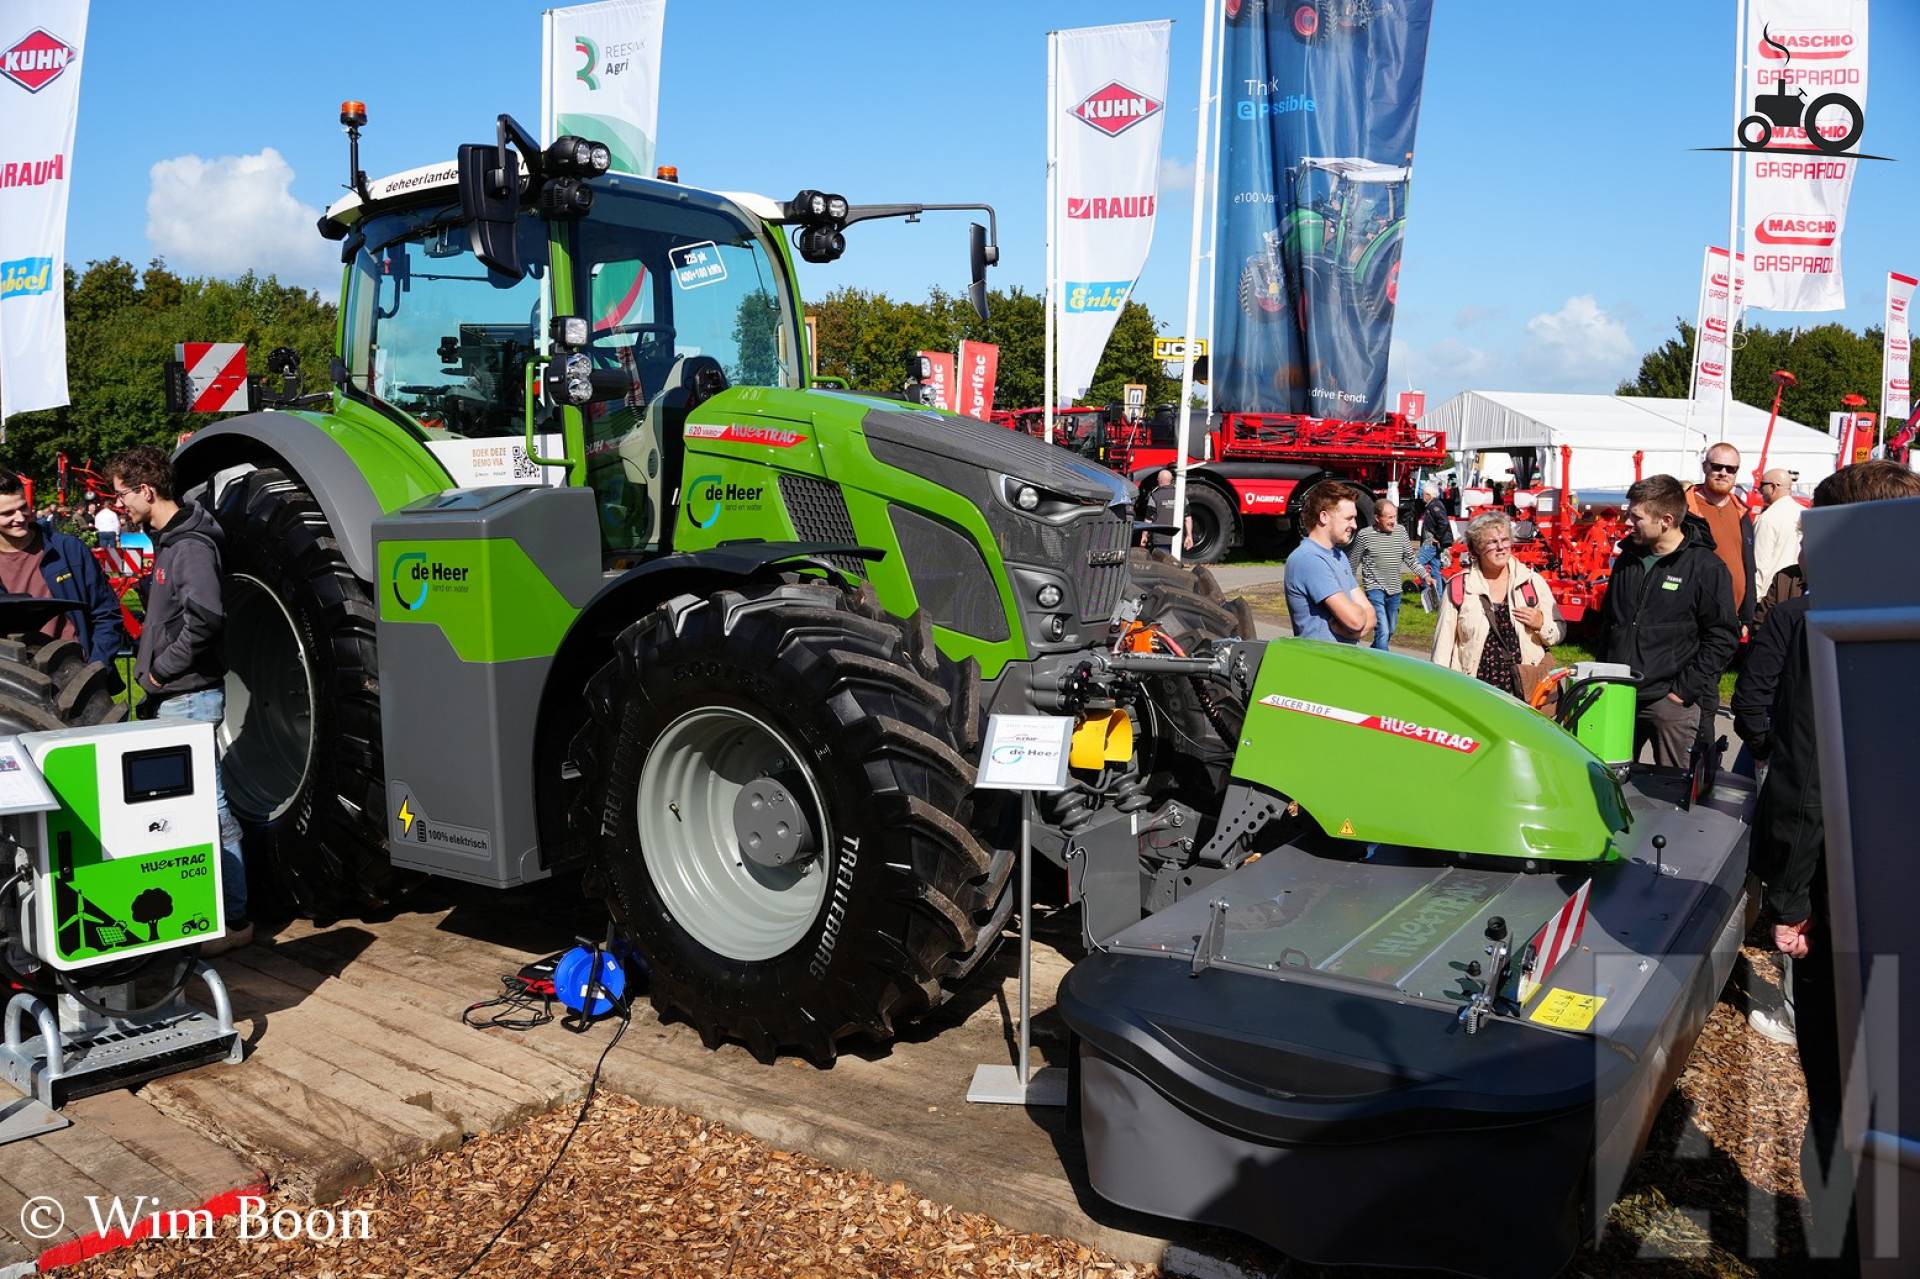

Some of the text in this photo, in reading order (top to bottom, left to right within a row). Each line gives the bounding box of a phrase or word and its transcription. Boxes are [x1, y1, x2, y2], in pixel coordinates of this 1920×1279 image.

[1772, 34, 1853, 47] MASCHIO
[5, 47, 68, 72] KUHN
[605, 58, 629, 76] Agri
[1244, 76, 1278, 96] Thk
[1757, 68, 1860, 85] GASPARDO
[1083, 98, 1148, 120] KUHN
[1772, 125, 1848, 139] MASHIO
[1756, 162, 1847, 180] GASPARDO
[385, 168, 458, 194] deheerlande
[1768, 219, 1837, 233] MASCHIO
[931, 363, 948, 410] grifac
[970, 354, 986, 419] Agrifac
[1311, 387, 1336, 400] drive
[705, 484, 763, 501] de Heer
[411, 562, 469, 581] de Heer
[1270, 695, 1304, 710] SLICER
[1304, 702, 1323, 715] 310
[1324, 707, 1332, 716] F
[427, 829, 488, 851] 100% elektrisch
[181, 866, 207, 880] DC40
[809, 834, 861, 980] TRELLEBORG
